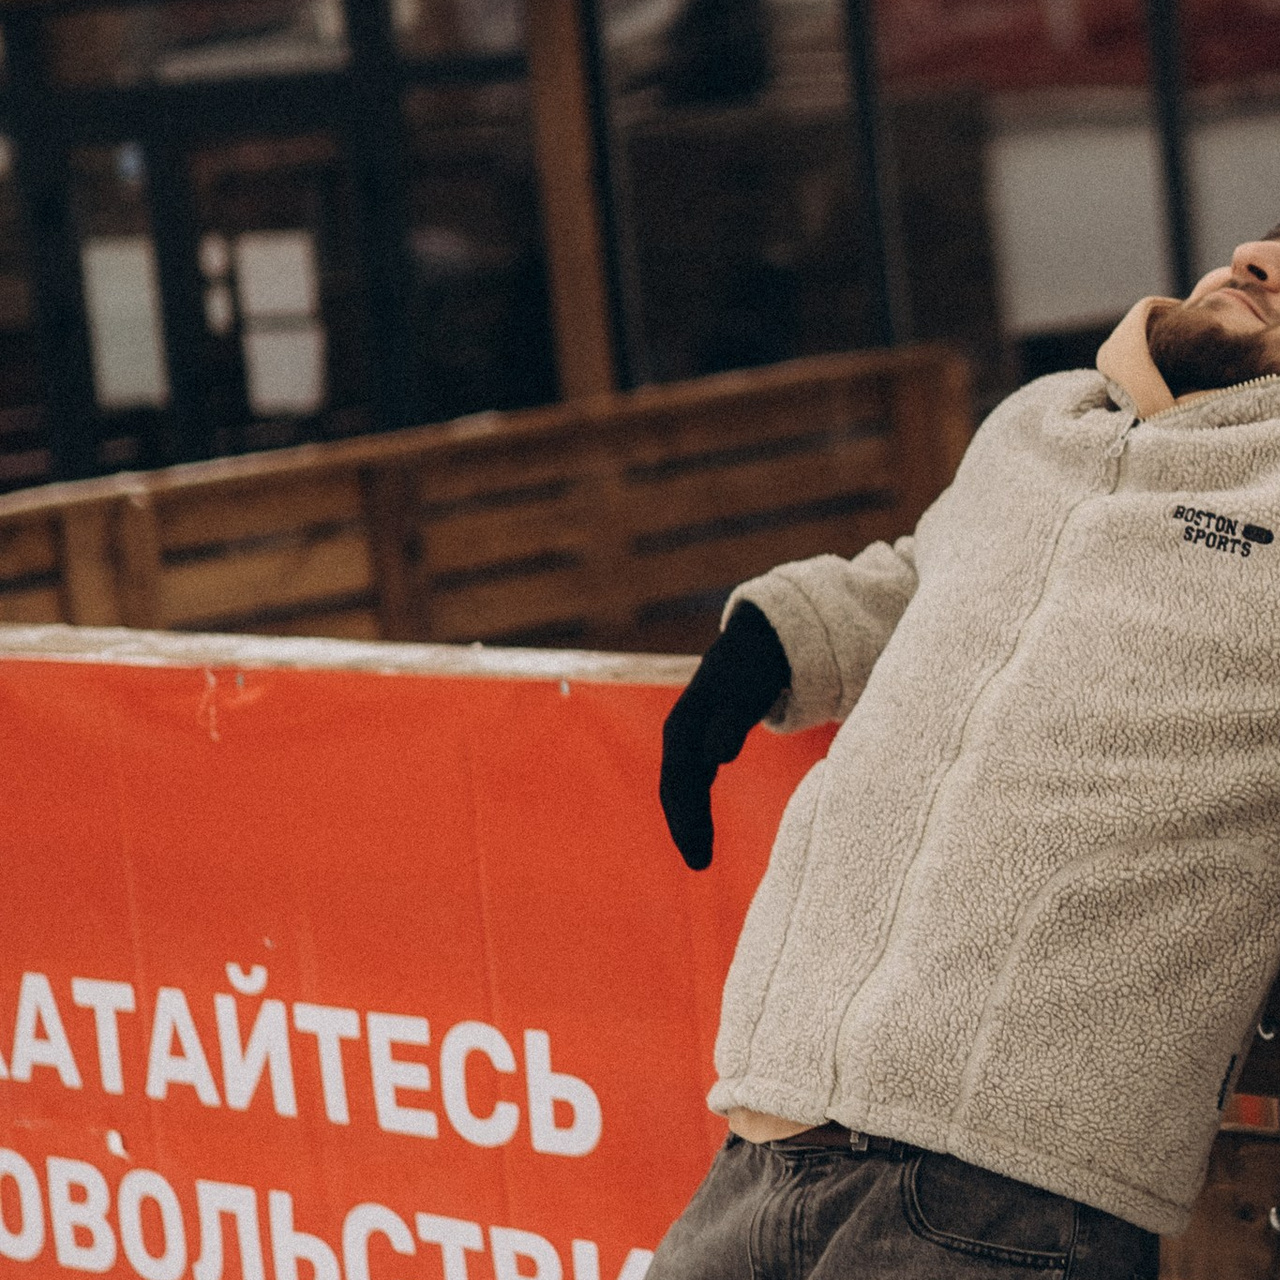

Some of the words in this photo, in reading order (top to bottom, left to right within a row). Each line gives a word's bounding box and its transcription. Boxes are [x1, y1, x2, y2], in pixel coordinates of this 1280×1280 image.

[1173, 505, 1239, 536] BOSTON
[1183, 526, 1252, 558] SPORTS
[0, 962, 602, 1157] АТАЙТЕСЬ
